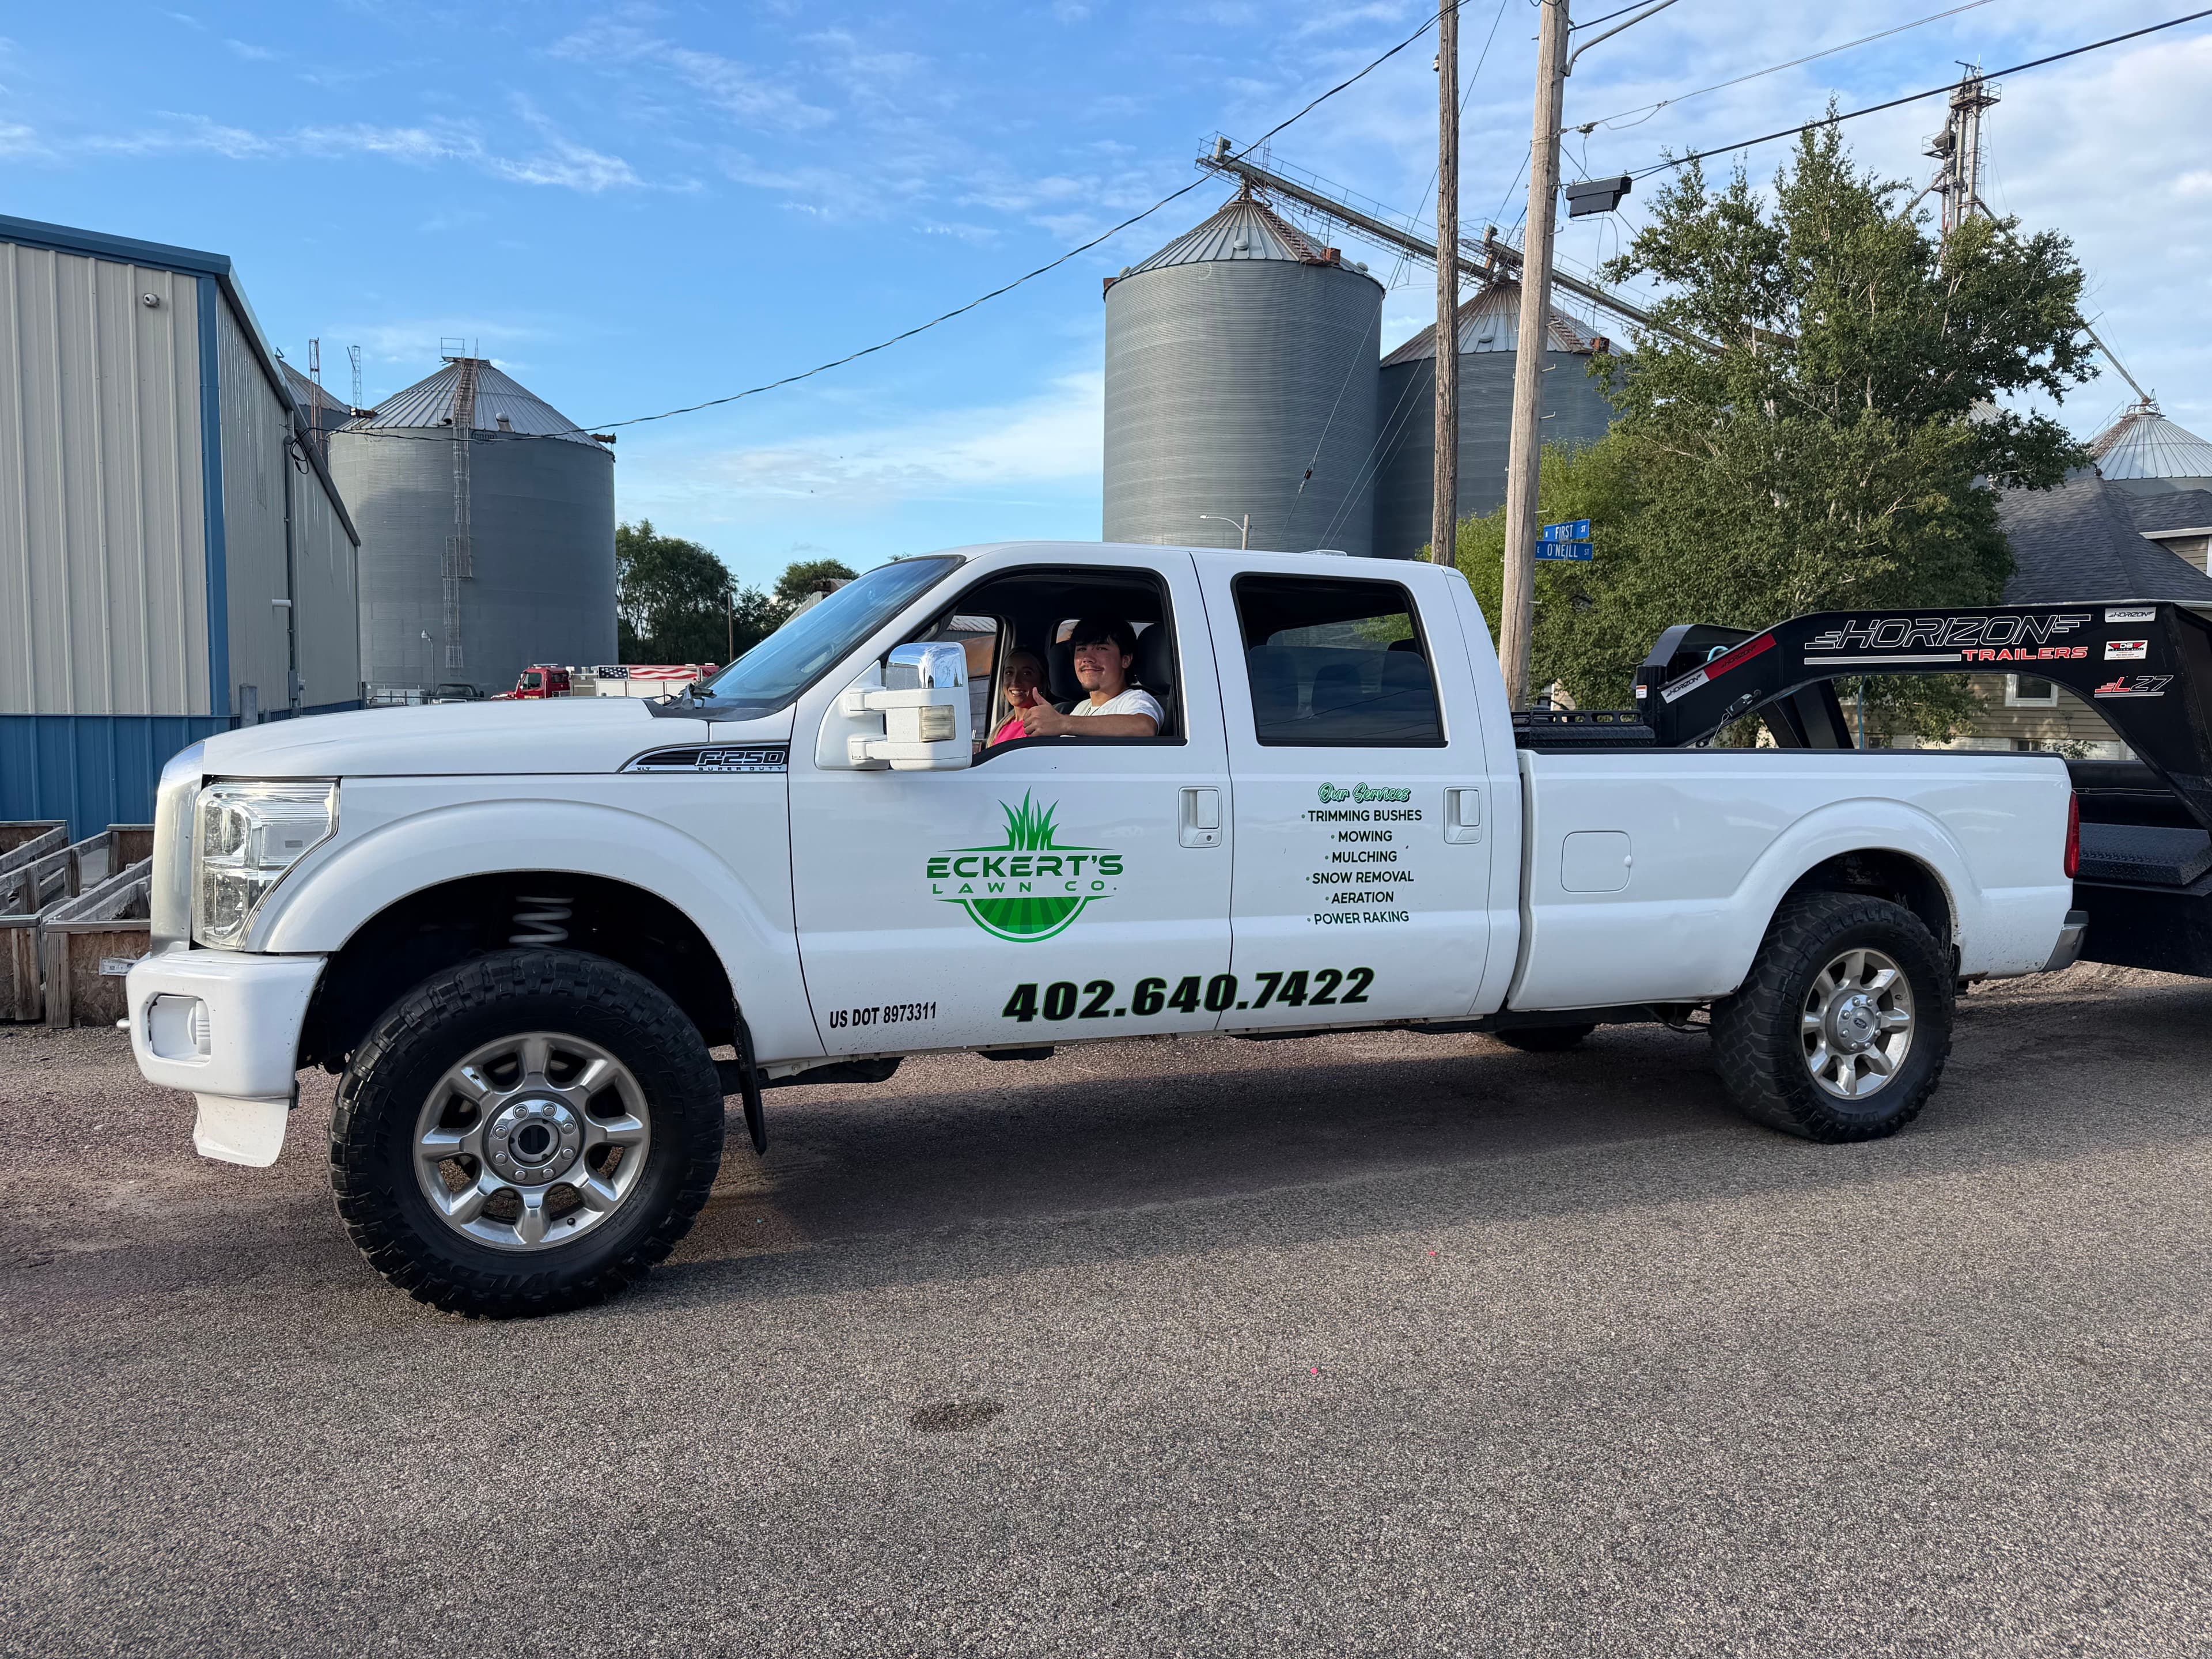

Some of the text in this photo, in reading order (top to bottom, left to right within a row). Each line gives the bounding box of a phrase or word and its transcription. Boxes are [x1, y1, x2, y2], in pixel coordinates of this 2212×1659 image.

[1555, 525, 1573, 539] FIRST
[1547, 544, 1578, 558] O'NEILL
[1836, 615, 2059, 649] HORIZON
[1962, 646, 2088, 661] TRAILERS
[1668, 676, 1700, 695] HORIZON
[1318, 782, 1411, 803] Our Services
[1308, 809, 1422, 822] TRIMMING BUSHES
[1338, 830, 1392, 842] MOWING
[1332, 851, 1397, 863] MULCHING
[927, 855, 1124, 878] ECKERT'S
[1312, 870, 1414, 884] SNOW REMOVAL
[932, 880, 1118, 894] LAWN CO.
[1331, 891, 1394, 904] AERATION
[1314, 911, 1410, 925] POWER RAKING
[1002, 967, 1375, 1023] 402.640.7422
[830, 1001, 937, 1029] US DOT 8973311
